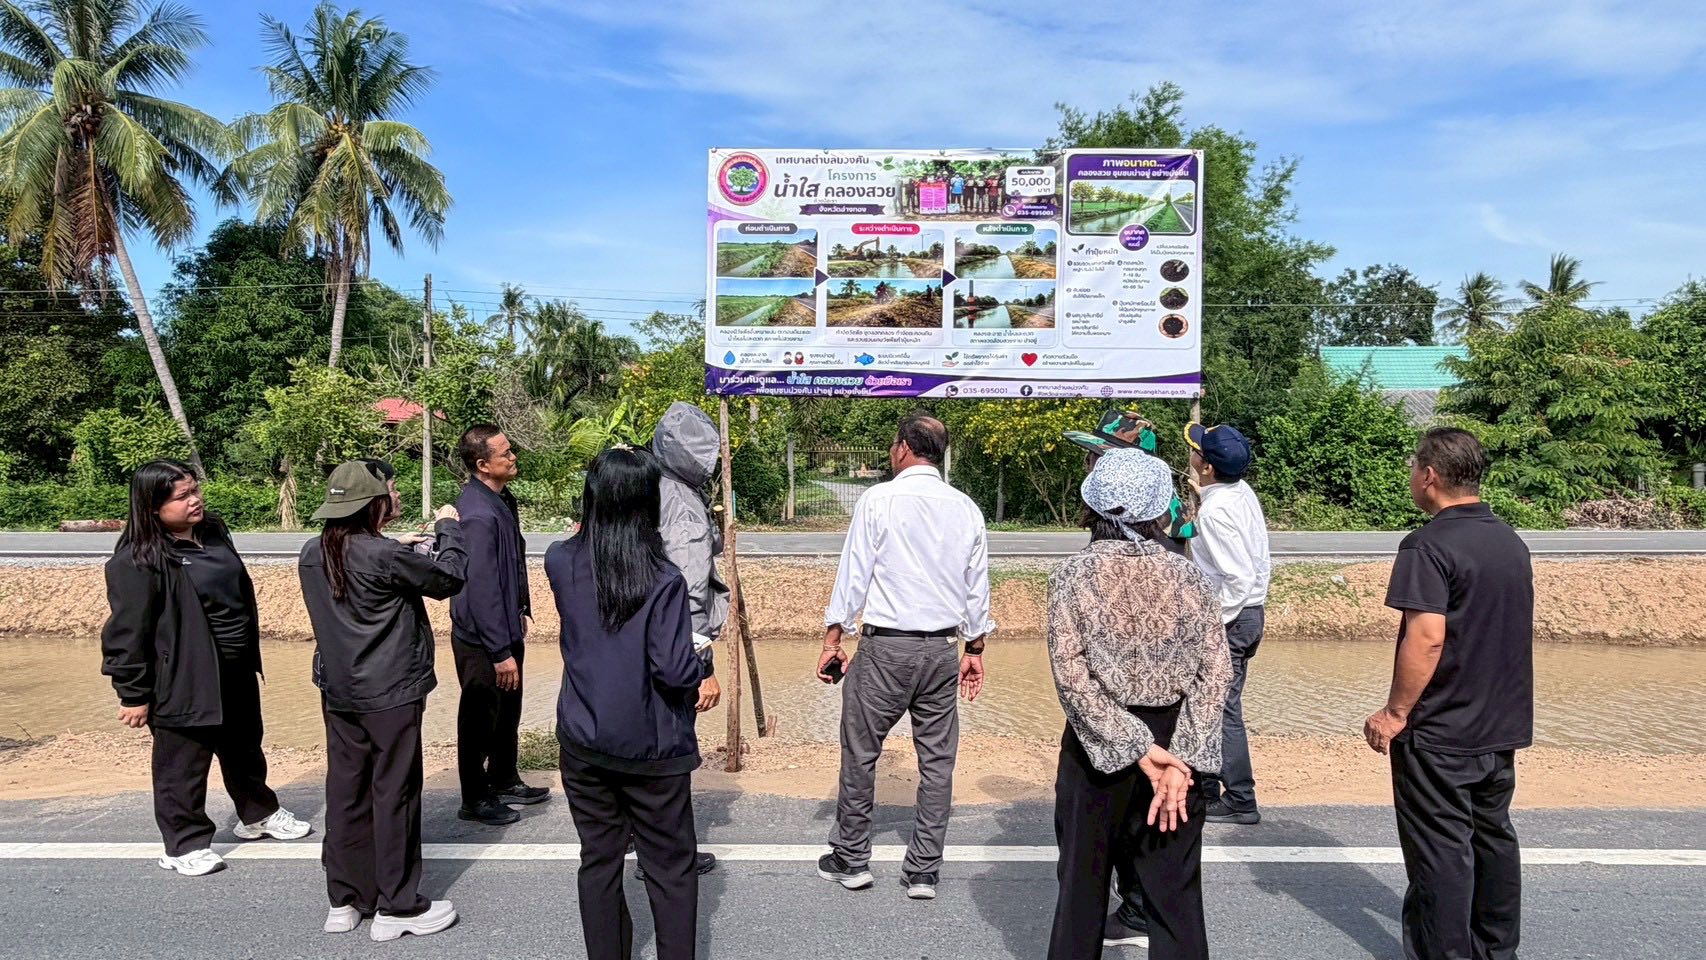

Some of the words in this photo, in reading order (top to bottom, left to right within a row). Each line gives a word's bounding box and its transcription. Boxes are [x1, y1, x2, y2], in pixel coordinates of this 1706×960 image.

[827, 169, 877, 181] โครงการ
[773, 173, 821, 198] น้ำใส
[824, 185, 896, 198] คลองสวย
[1011, 177, 1051, 187] 50,000
[858, 225, 913, 233] ระหว่างดำเนินการ
[982, 225, 1028, 233] หลังดำเนินการ
[1085, 247, 1119, 257] ทำปุ๋ยหมัก
[719, 374, 785, 388] มาร่วมกันดูแล...
[786, 371, 813, 385] น้ำใส
[812, 376, 864, 385] คลองสวย
[864, 374, 913, 387] ด้วยมือเรา
[1117, 388, 1187, 396] www.muangkhan.go.th
